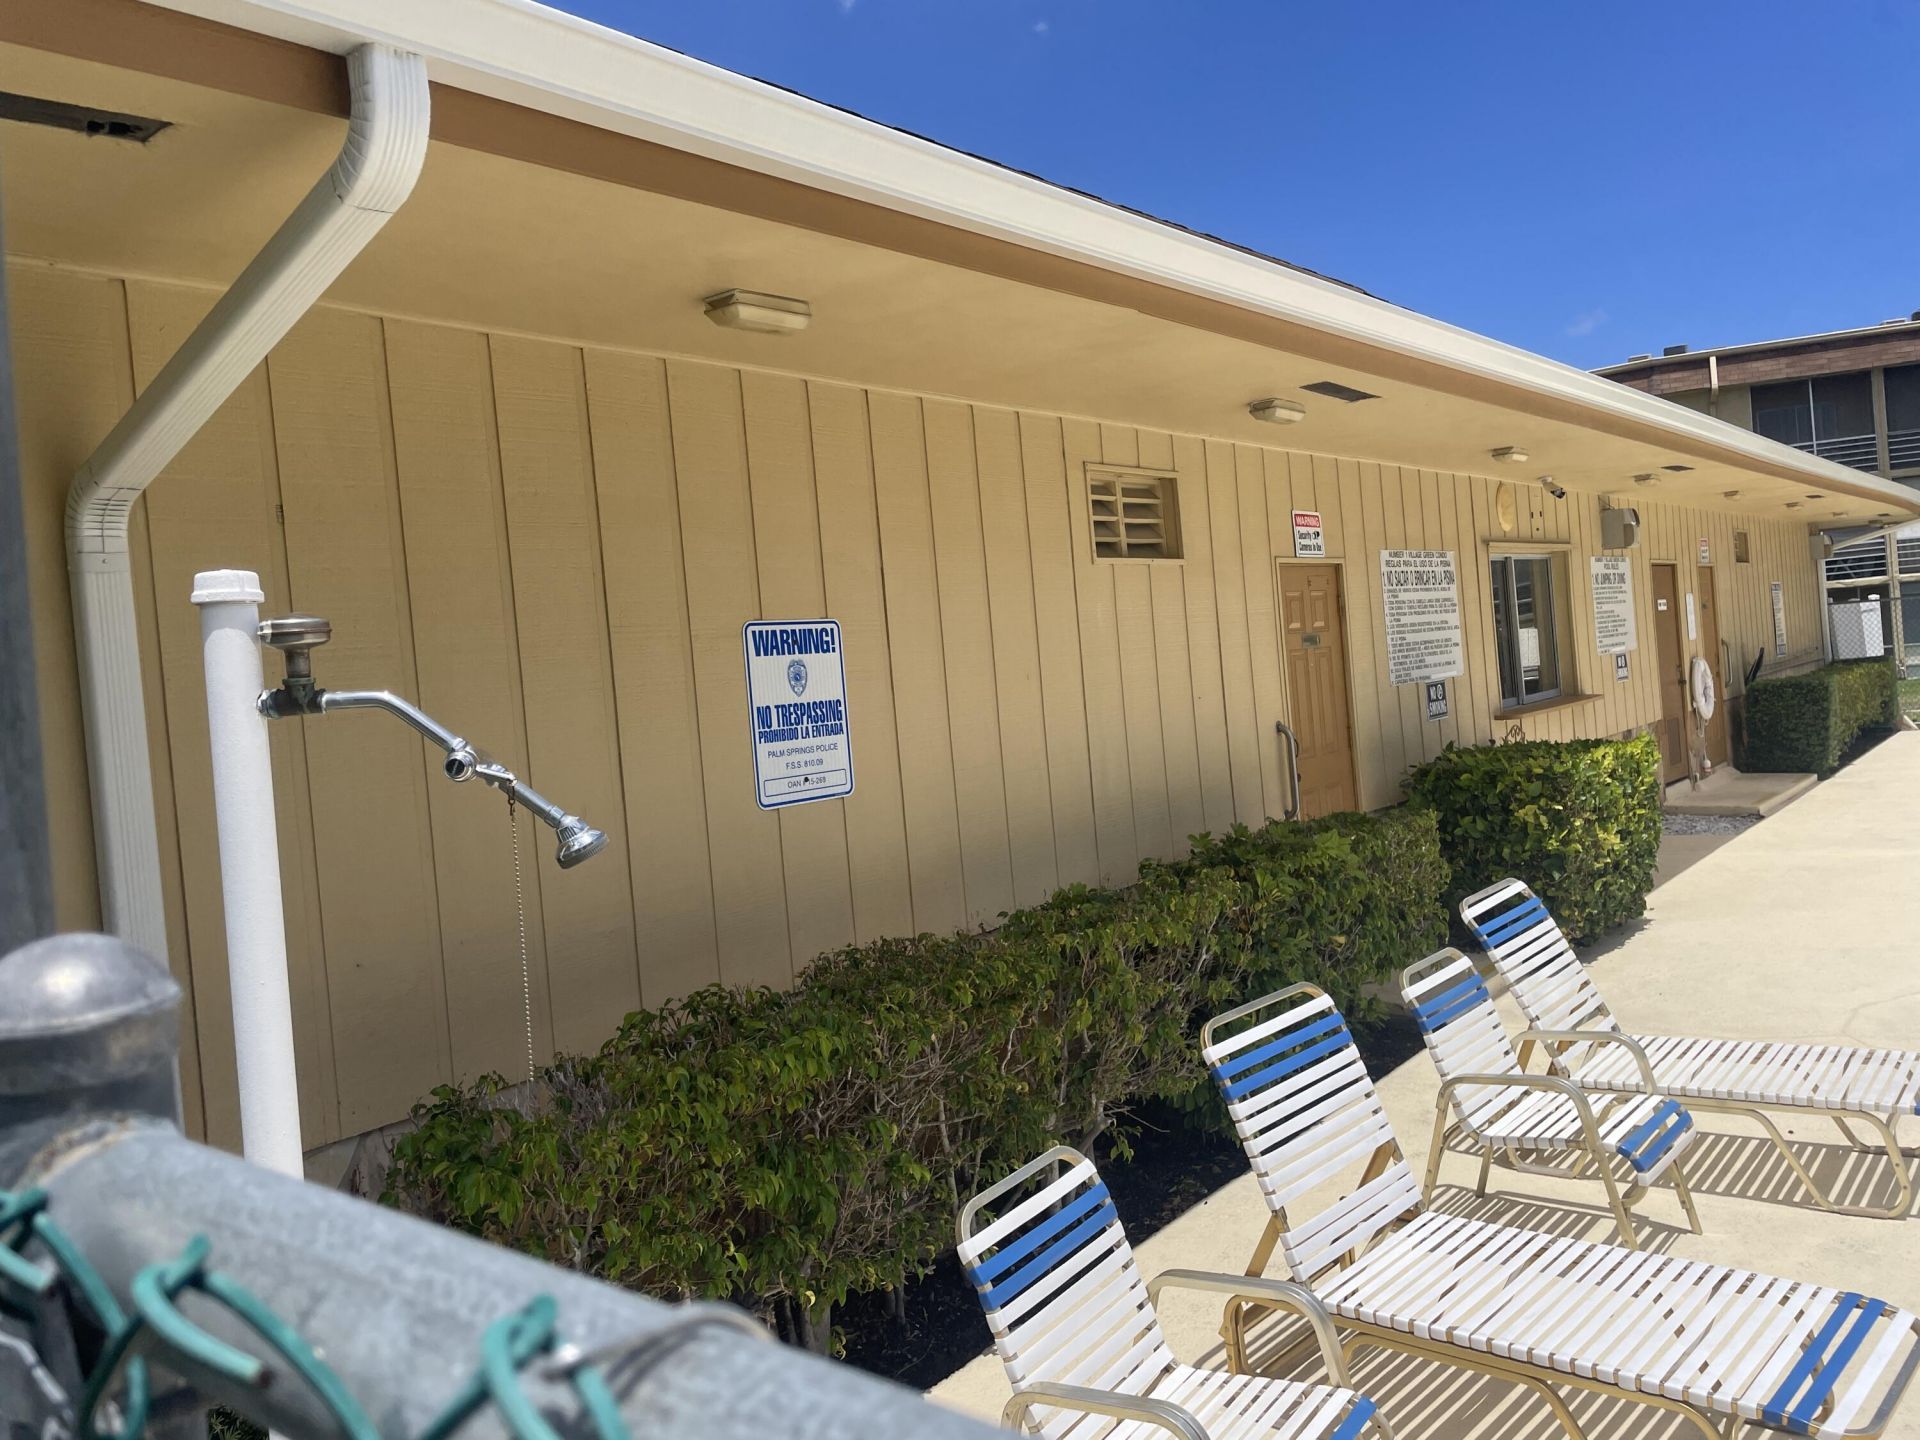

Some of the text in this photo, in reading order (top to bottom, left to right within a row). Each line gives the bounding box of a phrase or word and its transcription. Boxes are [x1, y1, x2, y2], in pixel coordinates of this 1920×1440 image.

[1295, 515, 1320, 527] WARNING
[1386, 570, 1393, 587] NO
[1394, 570, 1409, 587] SALTAR
[1414, 570, 1431, 586] BRINCAR
[751, 628, 836, 657] WARNING!
[756, 699, 843, 730] NO TRESPASSING
[758, 723, 844, 744] PROHIBIDO LA ENTRADA
[767, 743, 838, 758] PALM SPRINGS POLICE
[785, 759, 824, 770] F.S.S. 810.09
